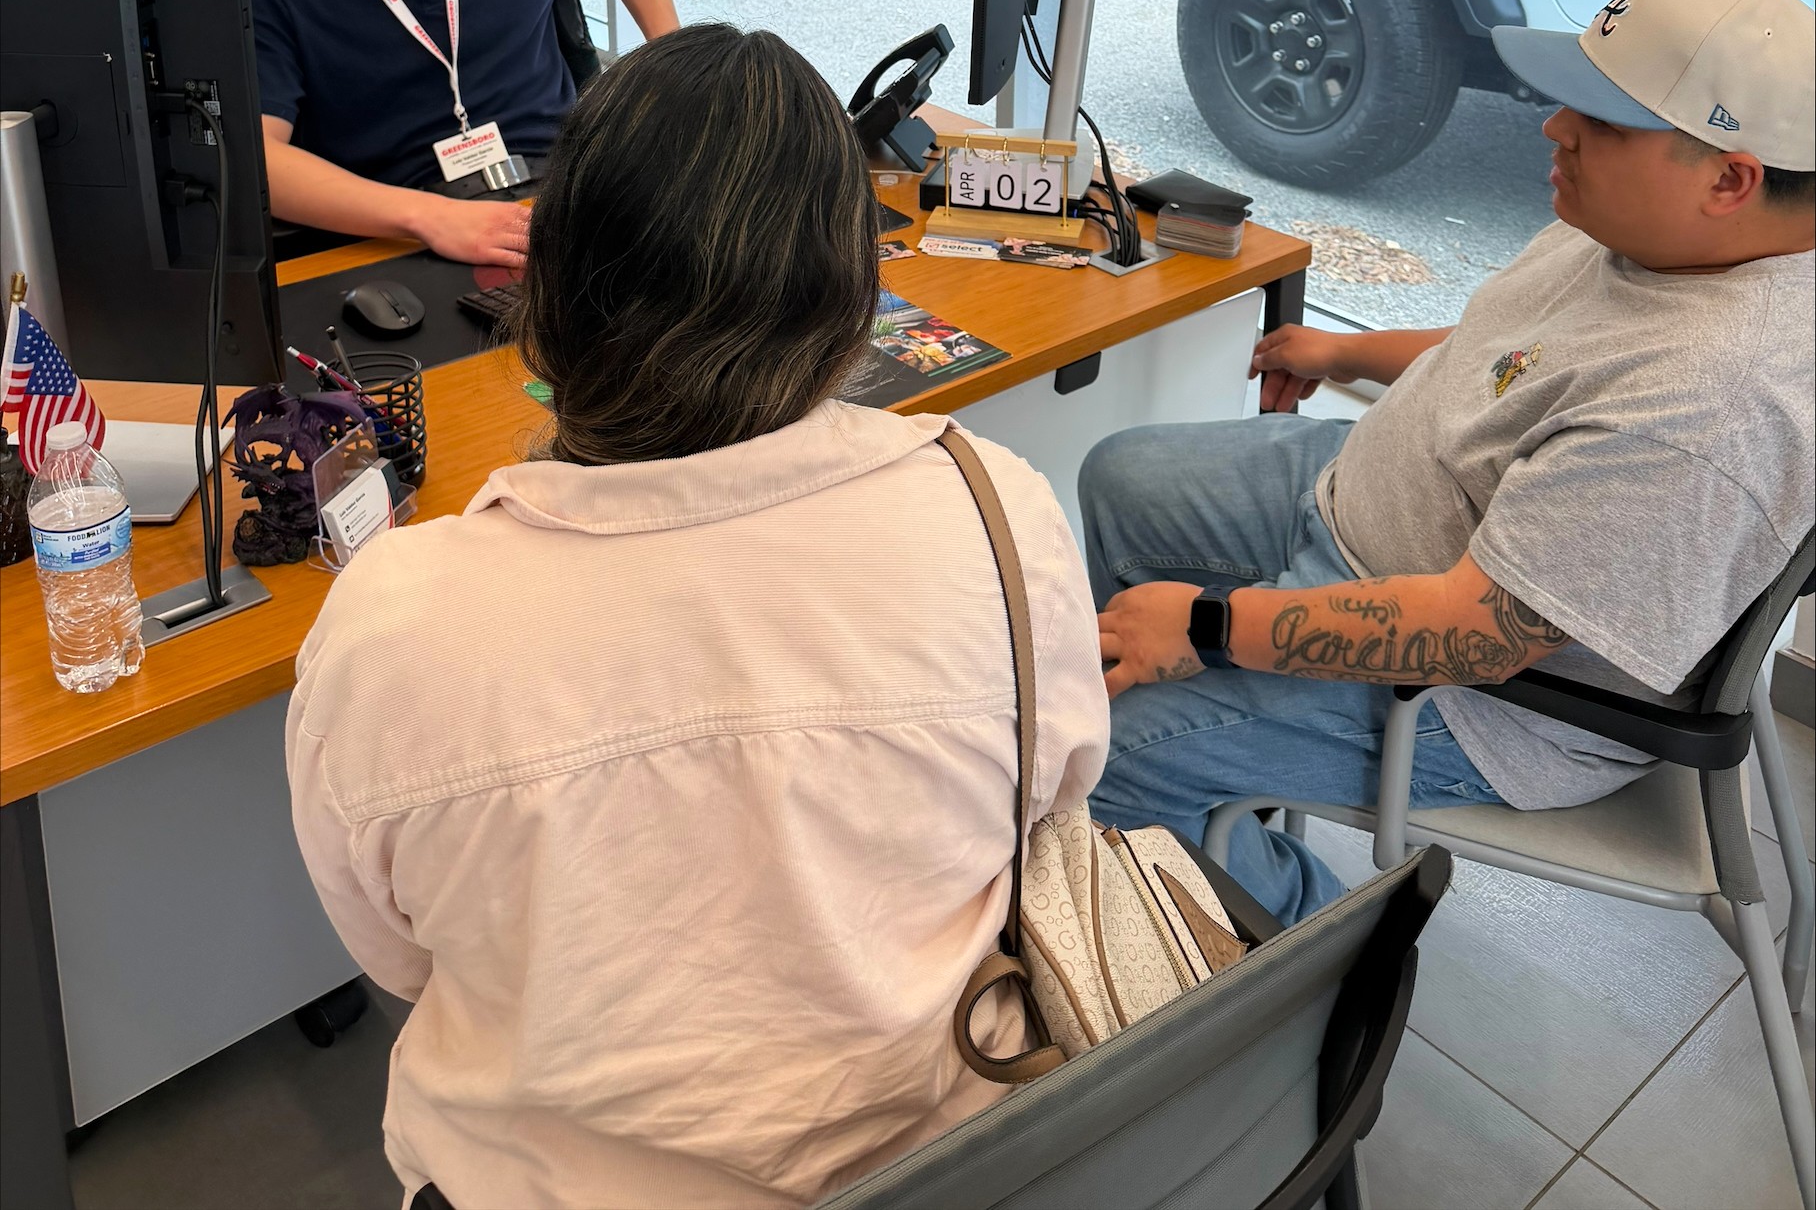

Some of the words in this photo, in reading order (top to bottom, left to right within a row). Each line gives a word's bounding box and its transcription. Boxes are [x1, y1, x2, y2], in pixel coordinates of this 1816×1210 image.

[442, 132, 495, 157] GREENSBORO
[960, 171, 975, 201] APR
[941, 243, 983, 253] select
[67, 533, 86, 542] FOOD
[96, 524, 111, 535] LION
[82, 540, 100, 548] Water
